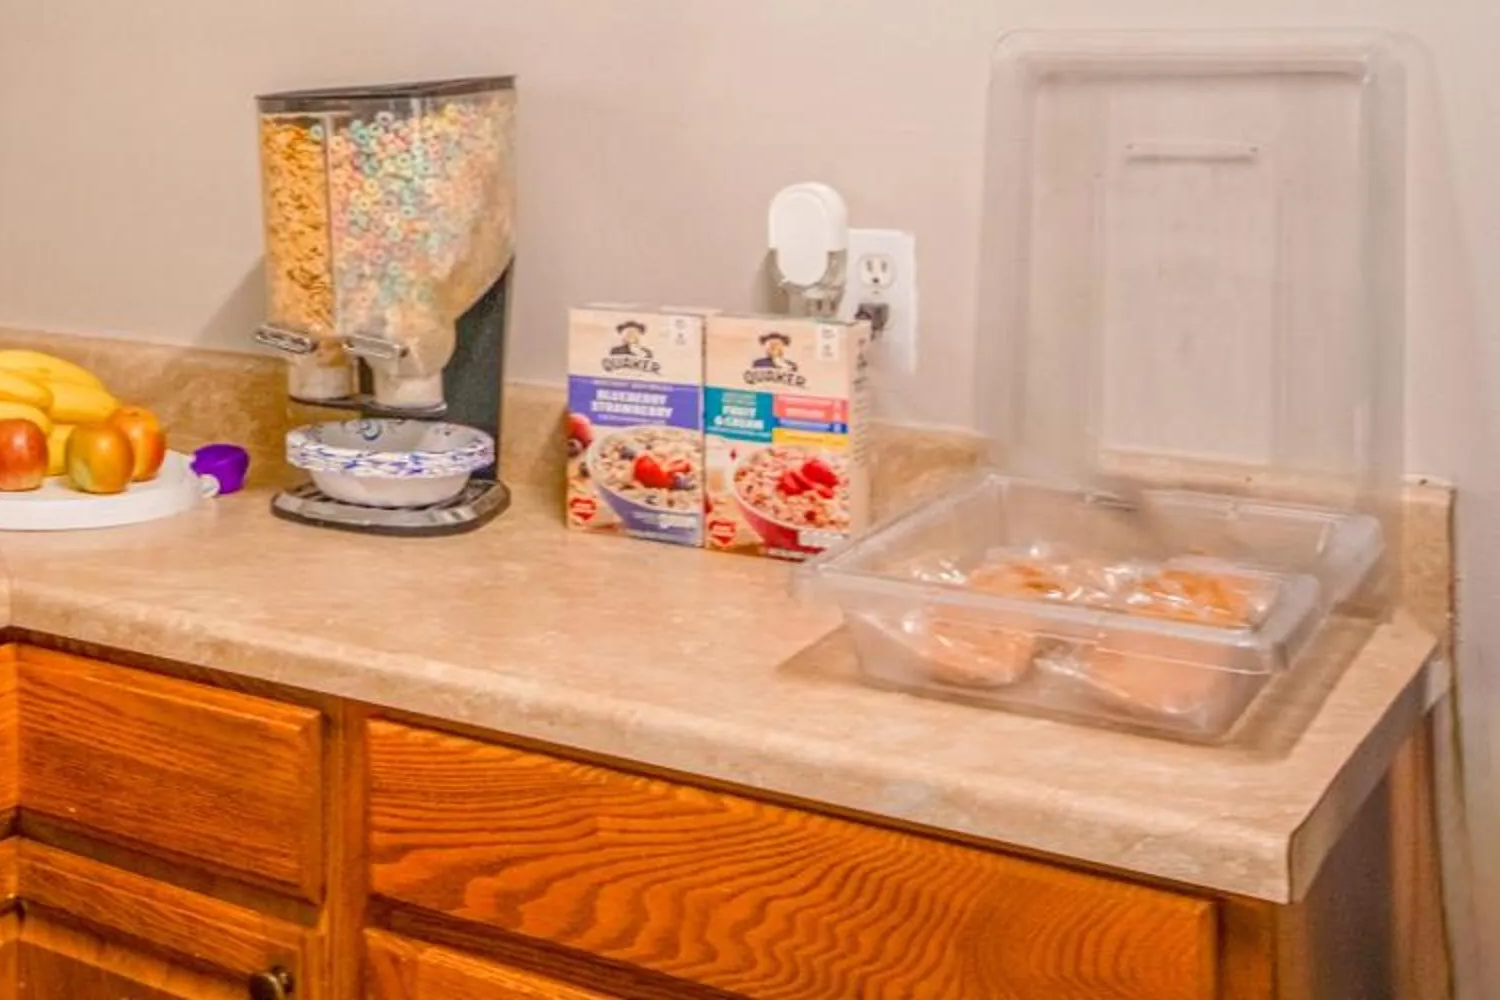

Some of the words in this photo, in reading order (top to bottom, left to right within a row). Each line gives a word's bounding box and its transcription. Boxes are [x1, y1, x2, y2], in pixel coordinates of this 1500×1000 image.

[601, 356, 662, 375] QUAKER
[743, 369, 807, 388] QUAKER
[595, 388, 668, 405] BLUEBERRY
[591, 400, 673, 419] STRAWBERRY
